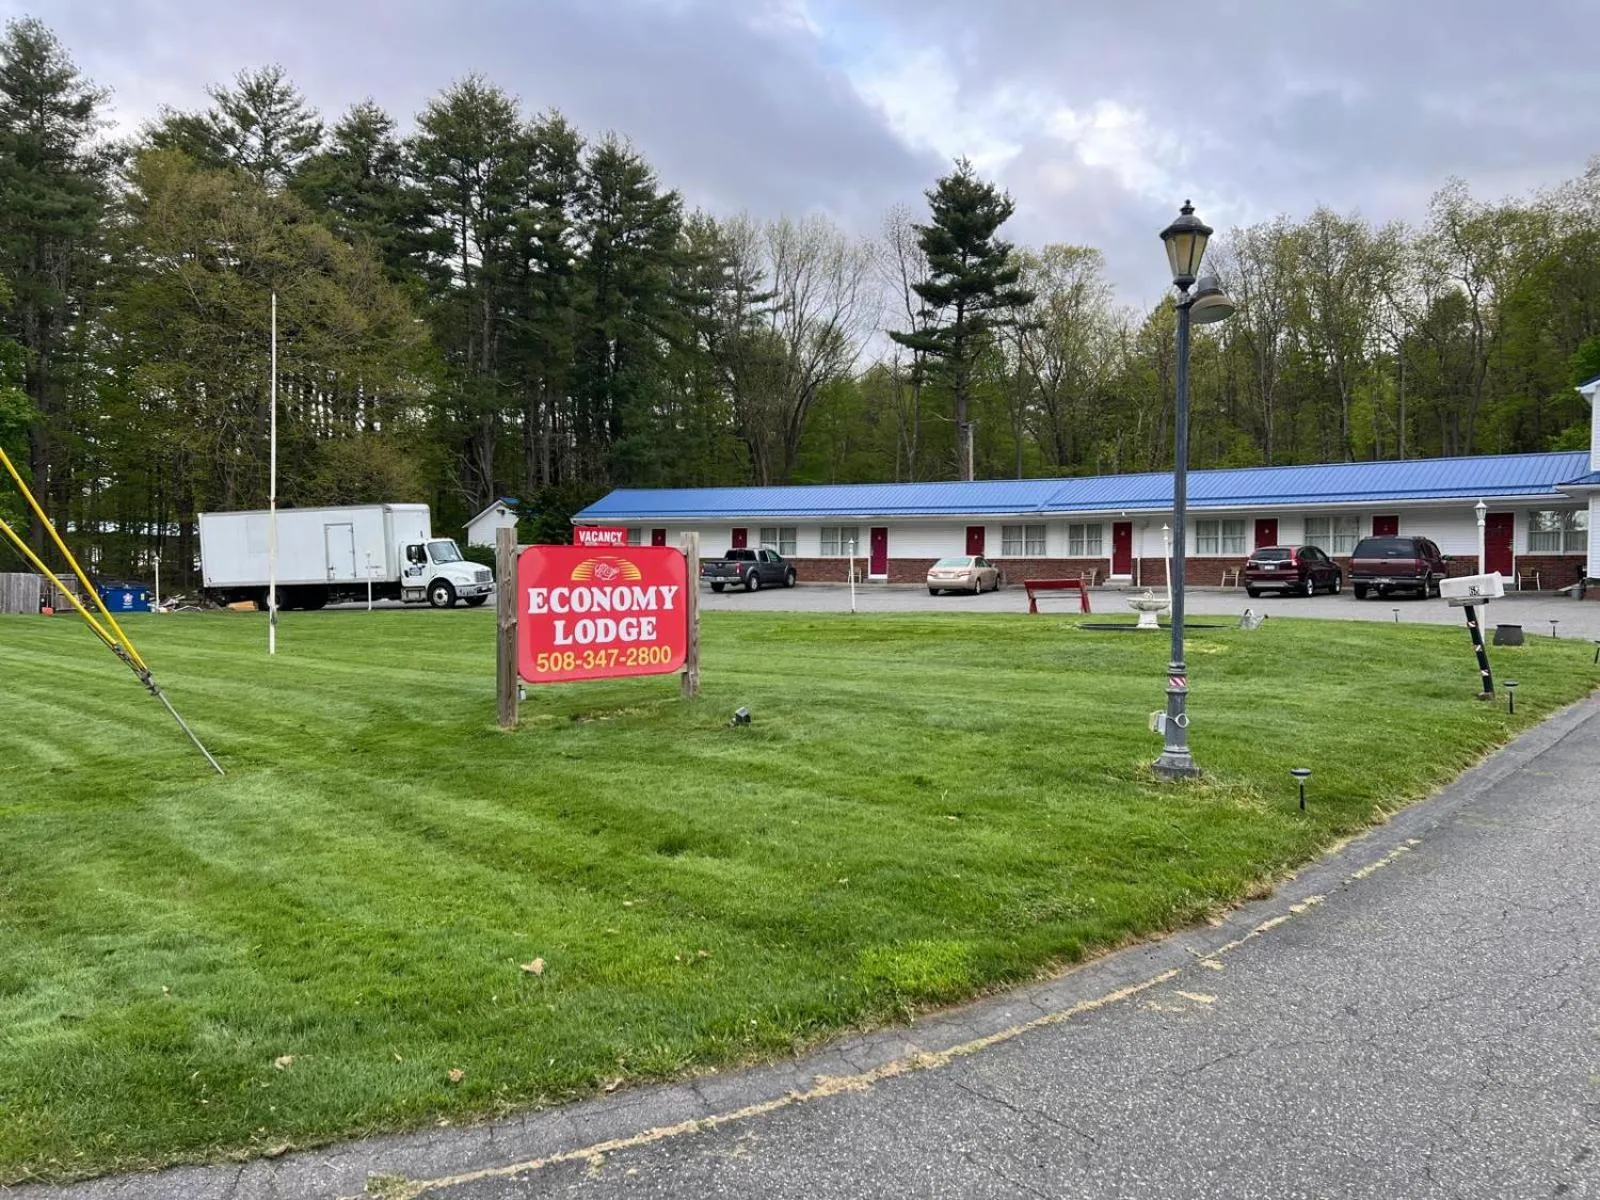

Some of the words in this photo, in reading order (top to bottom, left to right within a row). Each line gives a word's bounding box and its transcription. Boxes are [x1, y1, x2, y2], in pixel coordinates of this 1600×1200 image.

[579, 531, 622, 542] VACANCY
[527, 585, 679, 614] ECONOMY
[553, 616, 657, 645] LODGE
[536, 646, 671, 673] 508-347-2800
